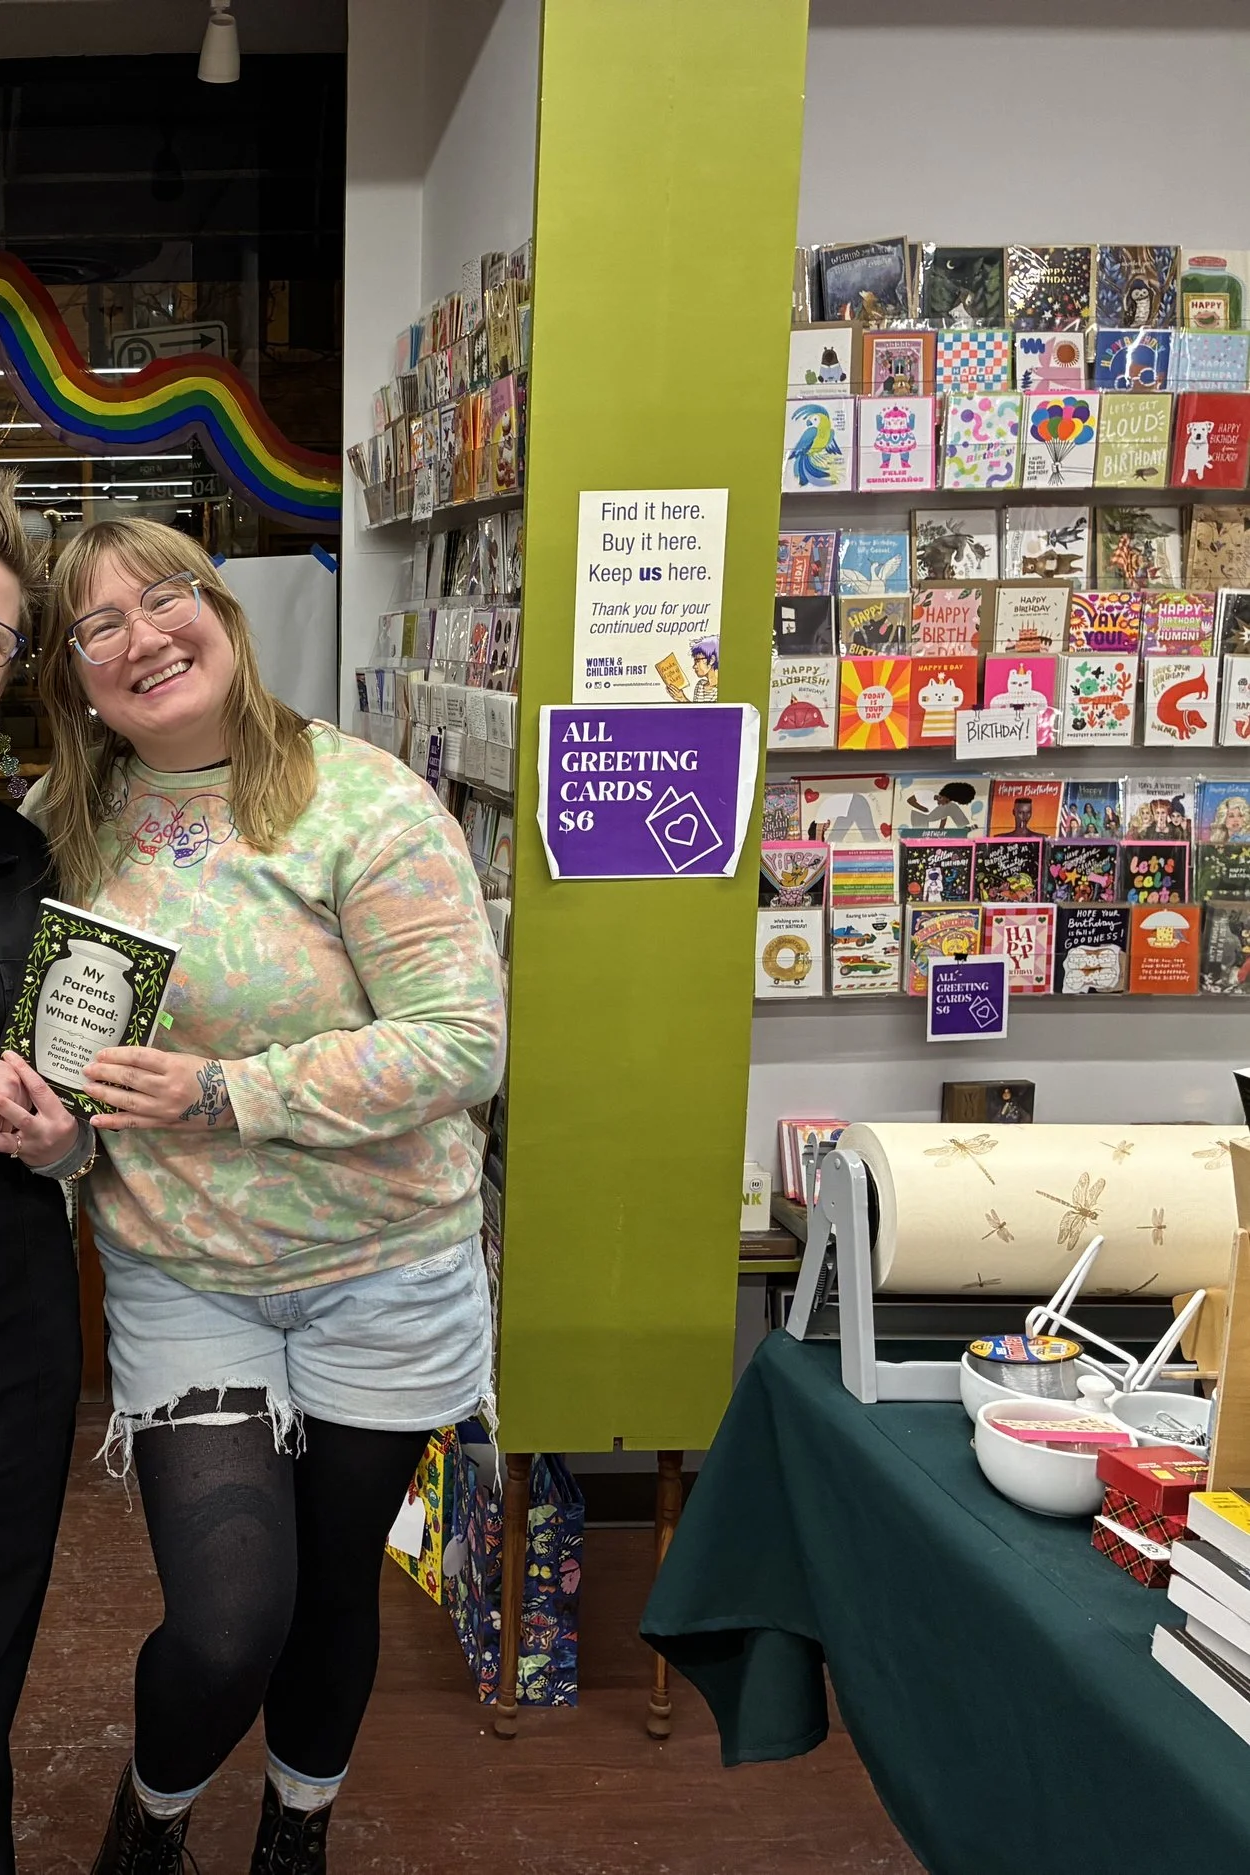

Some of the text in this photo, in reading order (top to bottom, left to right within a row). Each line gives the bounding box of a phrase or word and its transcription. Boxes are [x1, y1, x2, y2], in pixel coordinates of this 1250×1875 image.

[1191, 301, 1222, 309] HAPPY
[127, 347, 148, 368] P
[952, 367, 993, 375] HAPPY
[1138, 400, 1158, 412] GET
[1106, 414, 1158, 438] LOUD
[1218, 423, 1241, 432] HAPPY
[1210, 435, 1239, 444] BIRTHDAY
[1103, 448, 1166, 478] BIRTHDAY!
[866, 476, 924, 484] CUMPLEAÑOS
[601, 502, 705, 521] Find it here.
[602, 532, 701, 555] Buy it here.
[589, 562, 711, 586] Keep us here.
[1020, 596, 1047, 604] HAPPY
[592, 601, 710, 618] Thank you for your
[849, 602, 884, 628] HAPPY
[926, 607, 970, 623] HAPPY
[1159, 603, 1202, 615] HAPPY
[590, 619, 709, 635] continued support!
[1089, 613, 1121, 627] YAY
[922, 627, 967, 643] BIRTH
[1157, 631, 1200, 641] HUMAN!
[586, 656, 623, 667] WOMEN &
[586, 664, 647, 677] CHILDREN FIRST
[782, 665, 820, 675] HAPPY
[772, 675, 830, 688] BLOBFISH!
[561, 721, 613, 743] ALL
[967, 718, 1029, 742] BIRTHDAY!
[561, 750, 698, 772] GREETING
[560, 780, 653, 802] CARDS
[998, 784, 1059, 796] Happy Birthday
[1079, 786, 1103, 795] Happy
[558, 809, 594, 834] $6
[1077, 910, 1096, 918] HOPE
[1068, 918, 1122, 931] Birthday
[1064, 929, 1124, 949] GOODNESS!
[83, 966, 105, 983] My
[937, 973, 956, 981] ALL
[63, 976, 116, 1003] Parents
[937, 982, 989, 992] GREETING
[50, 990, 118, 1021] Are Dead:
[937, 994, 971, 1003] CARDS
[936, 1006, 950, 1014] $6
[46, 1004, 116, 1037] What Now?
[51, 1044, 69, 1055] Guide
[78, 1054, 90, 1062] the
[59, 1038, 92, 1055] Panic-Free
[60, 1064, 79, 1075] Death
